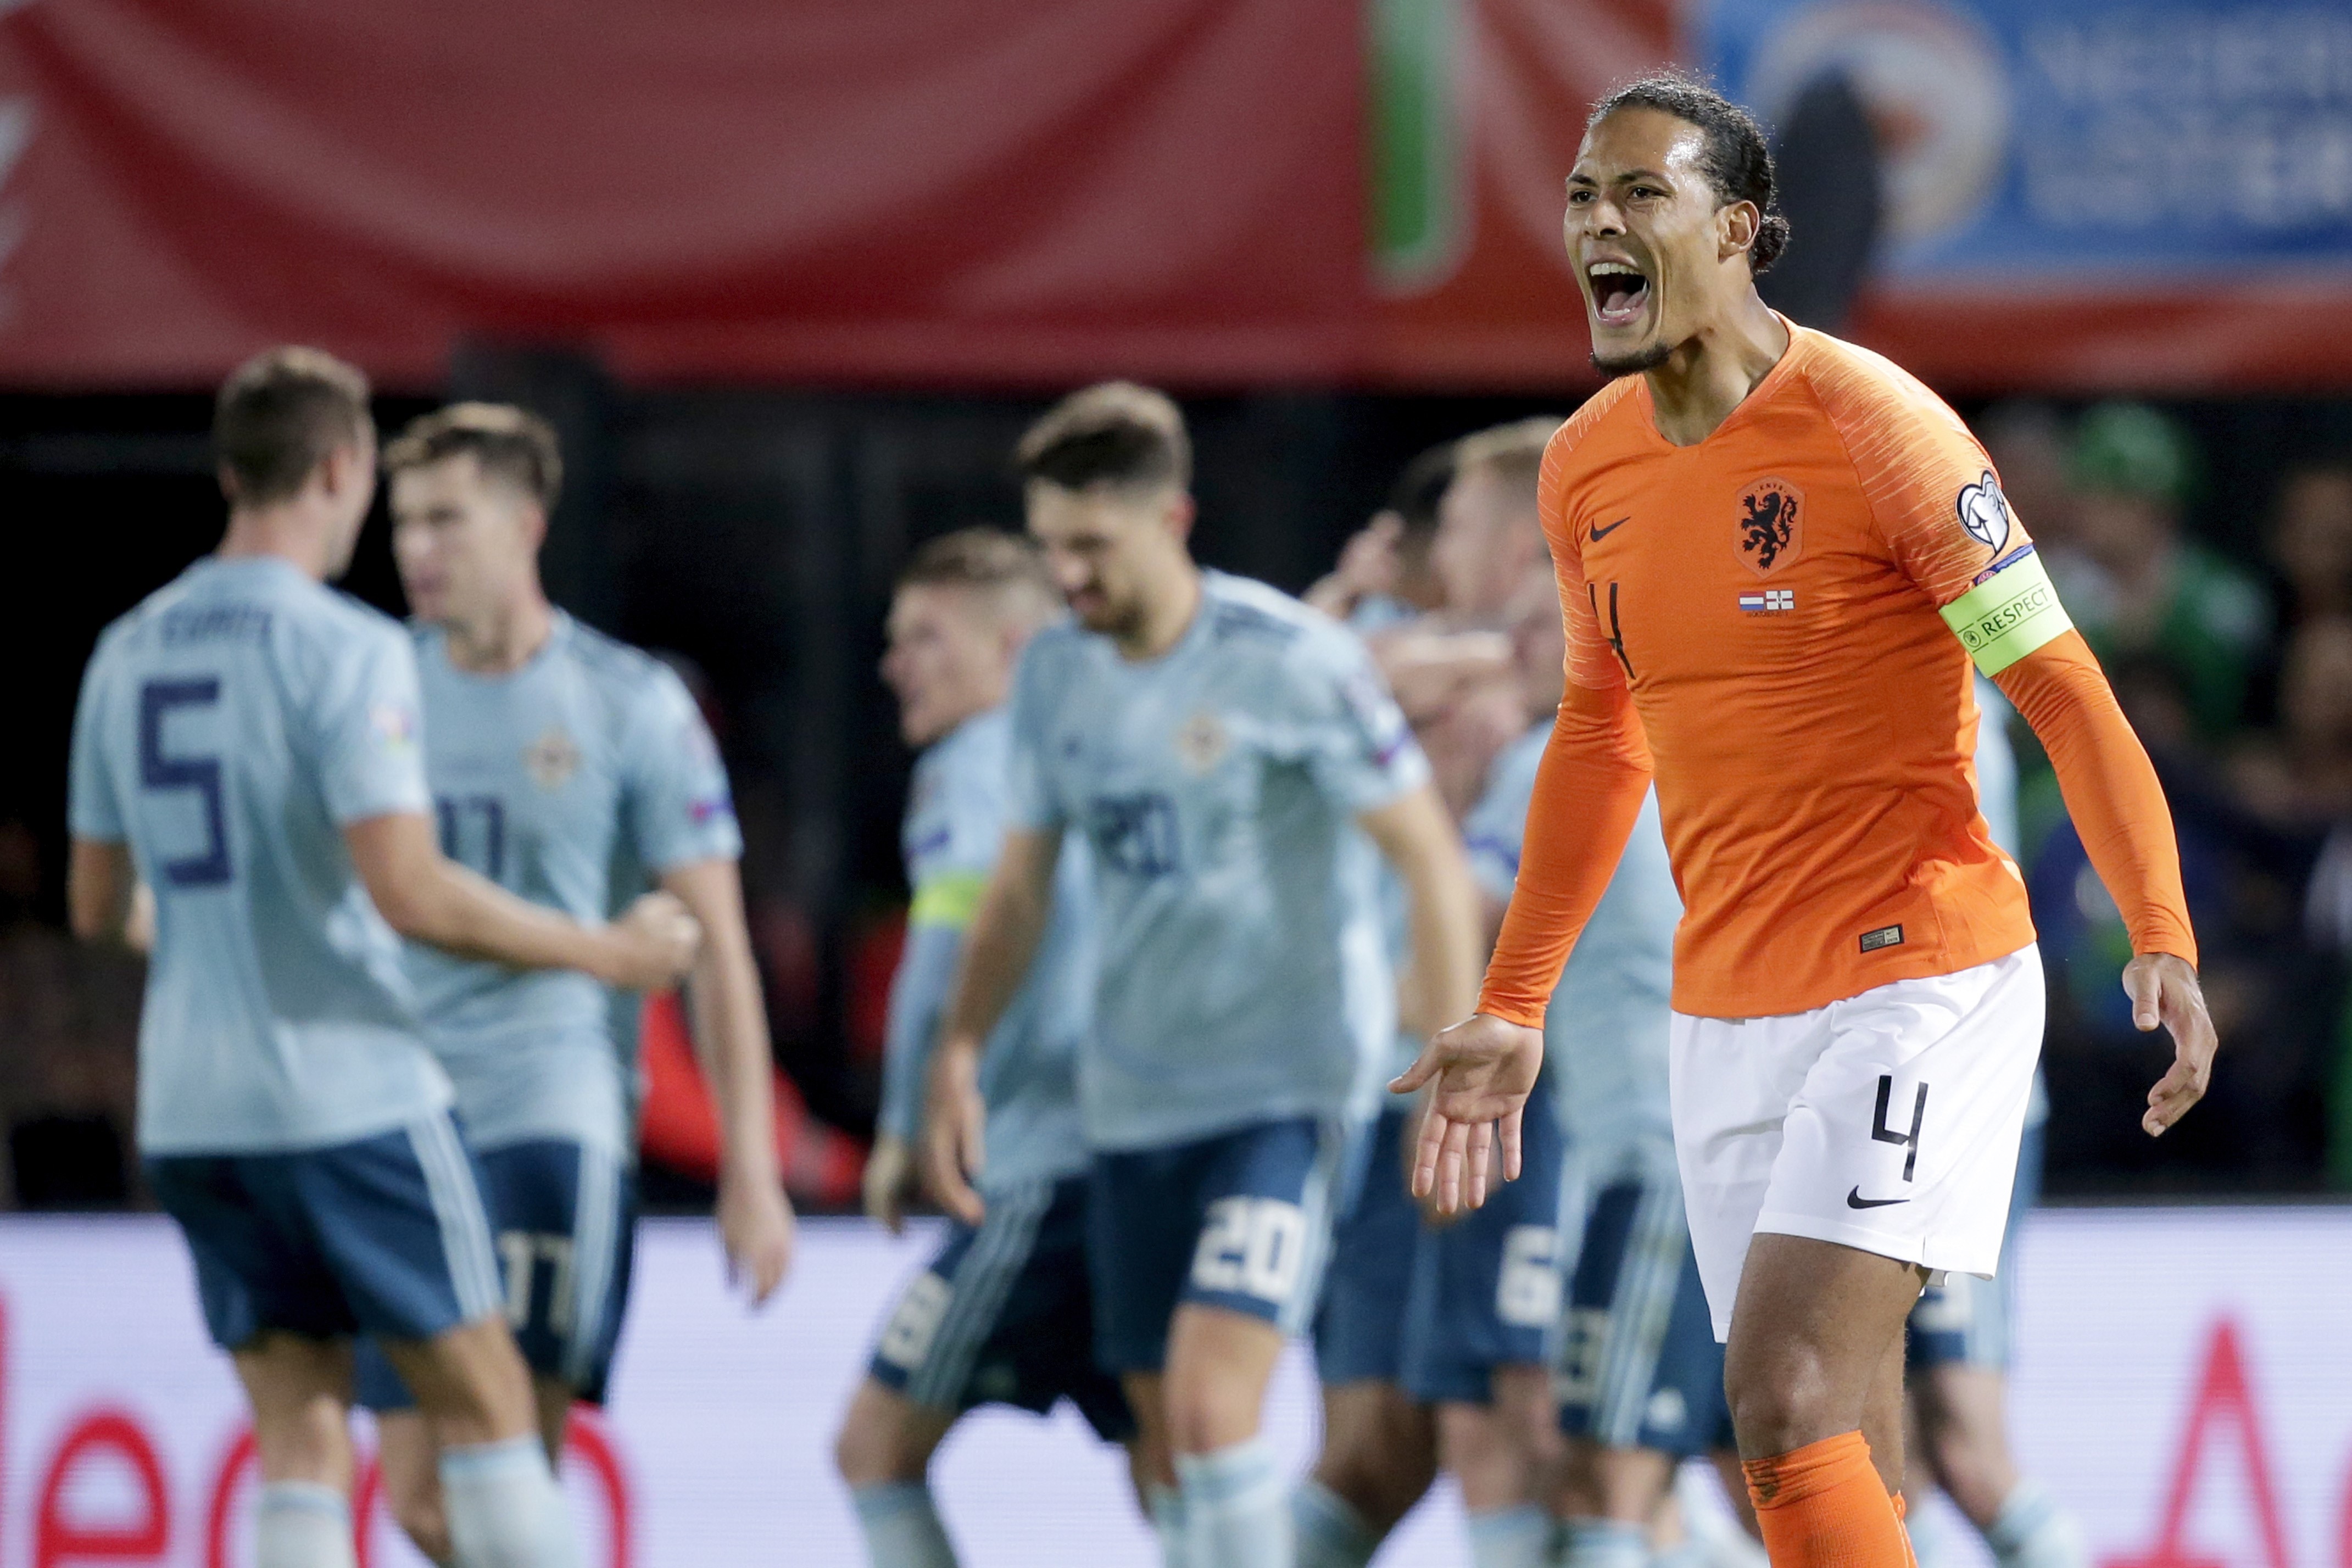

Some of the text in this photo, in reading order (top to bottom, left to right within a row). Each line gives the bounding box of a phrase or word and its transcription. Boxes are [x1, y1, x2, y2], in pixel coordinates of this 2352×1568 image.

[1981, 588, 2048, 636] RESPECT
[138, 677, 232, 885] 5
[1093, 793, 1180, 877] 20
[1872, 1075, 1929, 1182] 4
[1192, 1194, 1306, 1301] 20
[1495, 1225, 1564, 1325] 6
